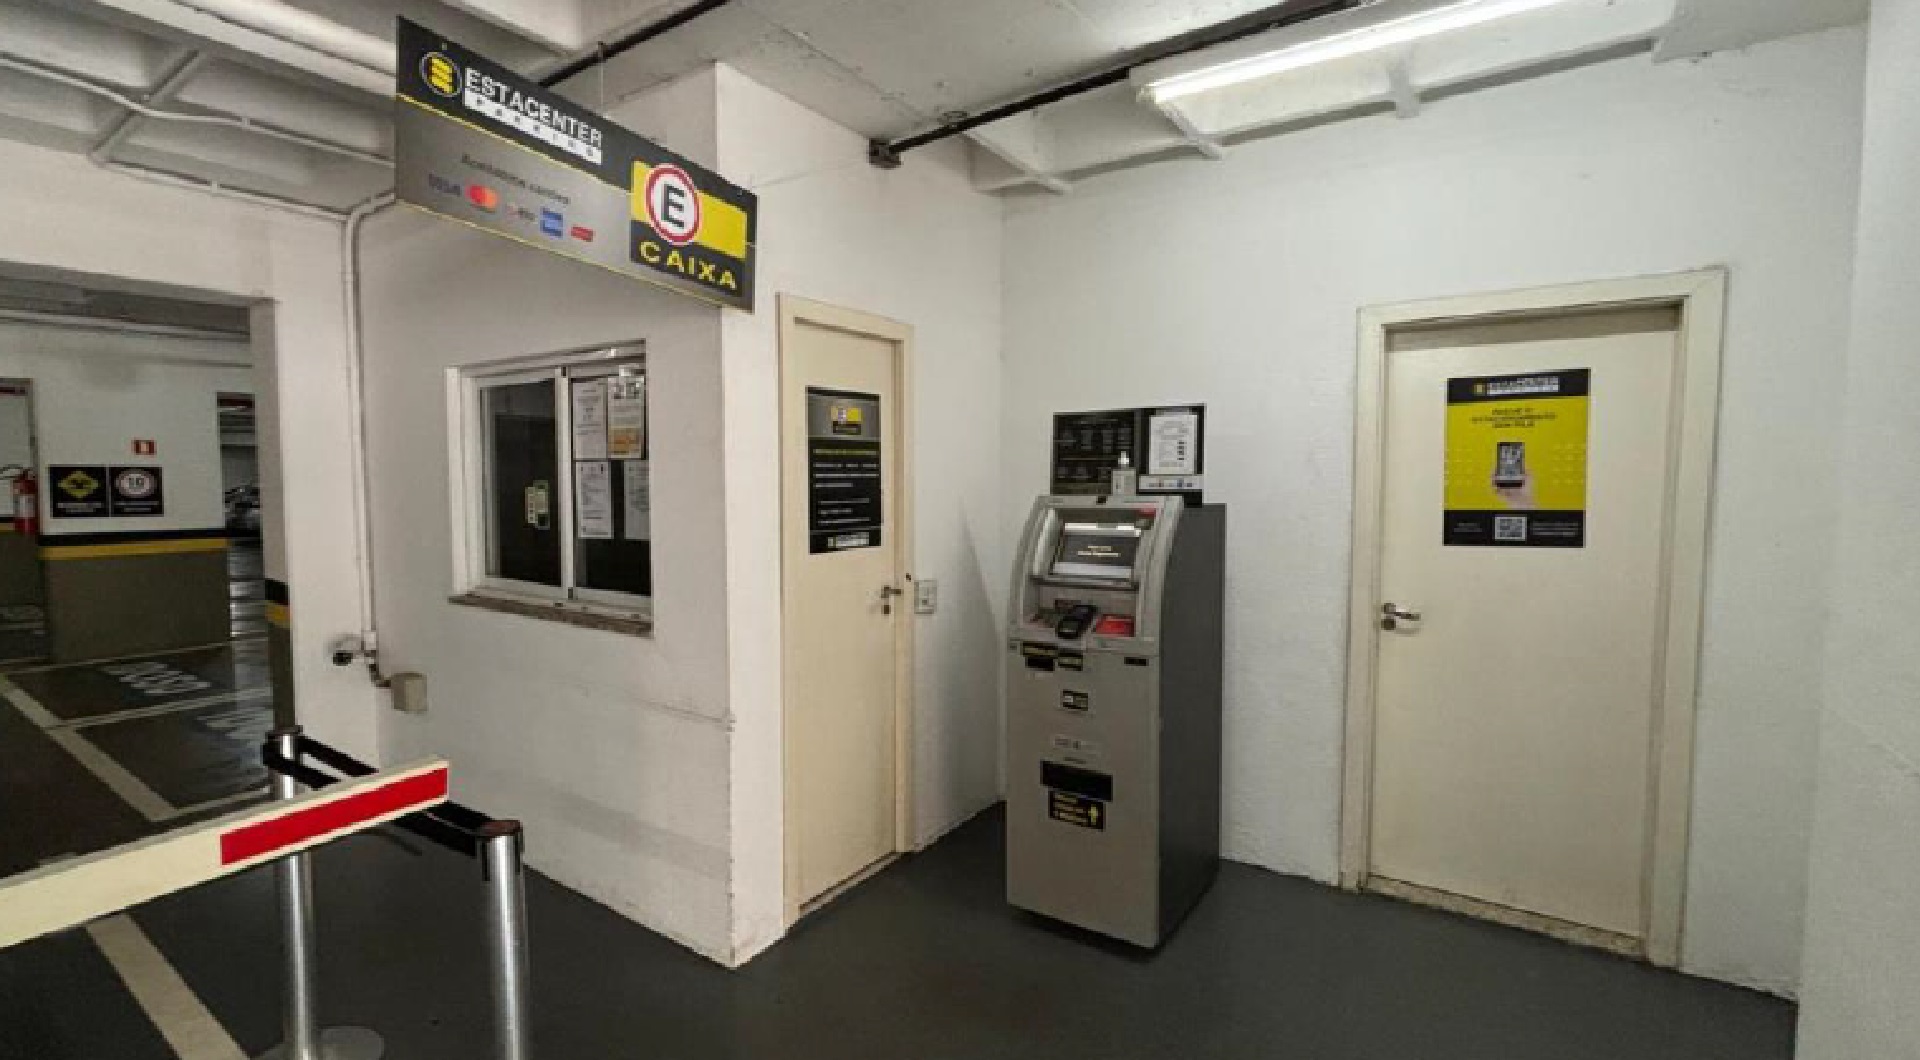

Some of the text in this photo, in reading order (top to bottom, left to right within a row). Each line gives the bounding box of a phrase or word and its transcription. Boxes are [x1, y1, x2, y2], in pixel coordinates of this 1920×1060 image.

[465, 66, 602, 146] ESTACENTER
[664, 183, 685, 228] E
[639, 241, 737, 289] CAIXA
